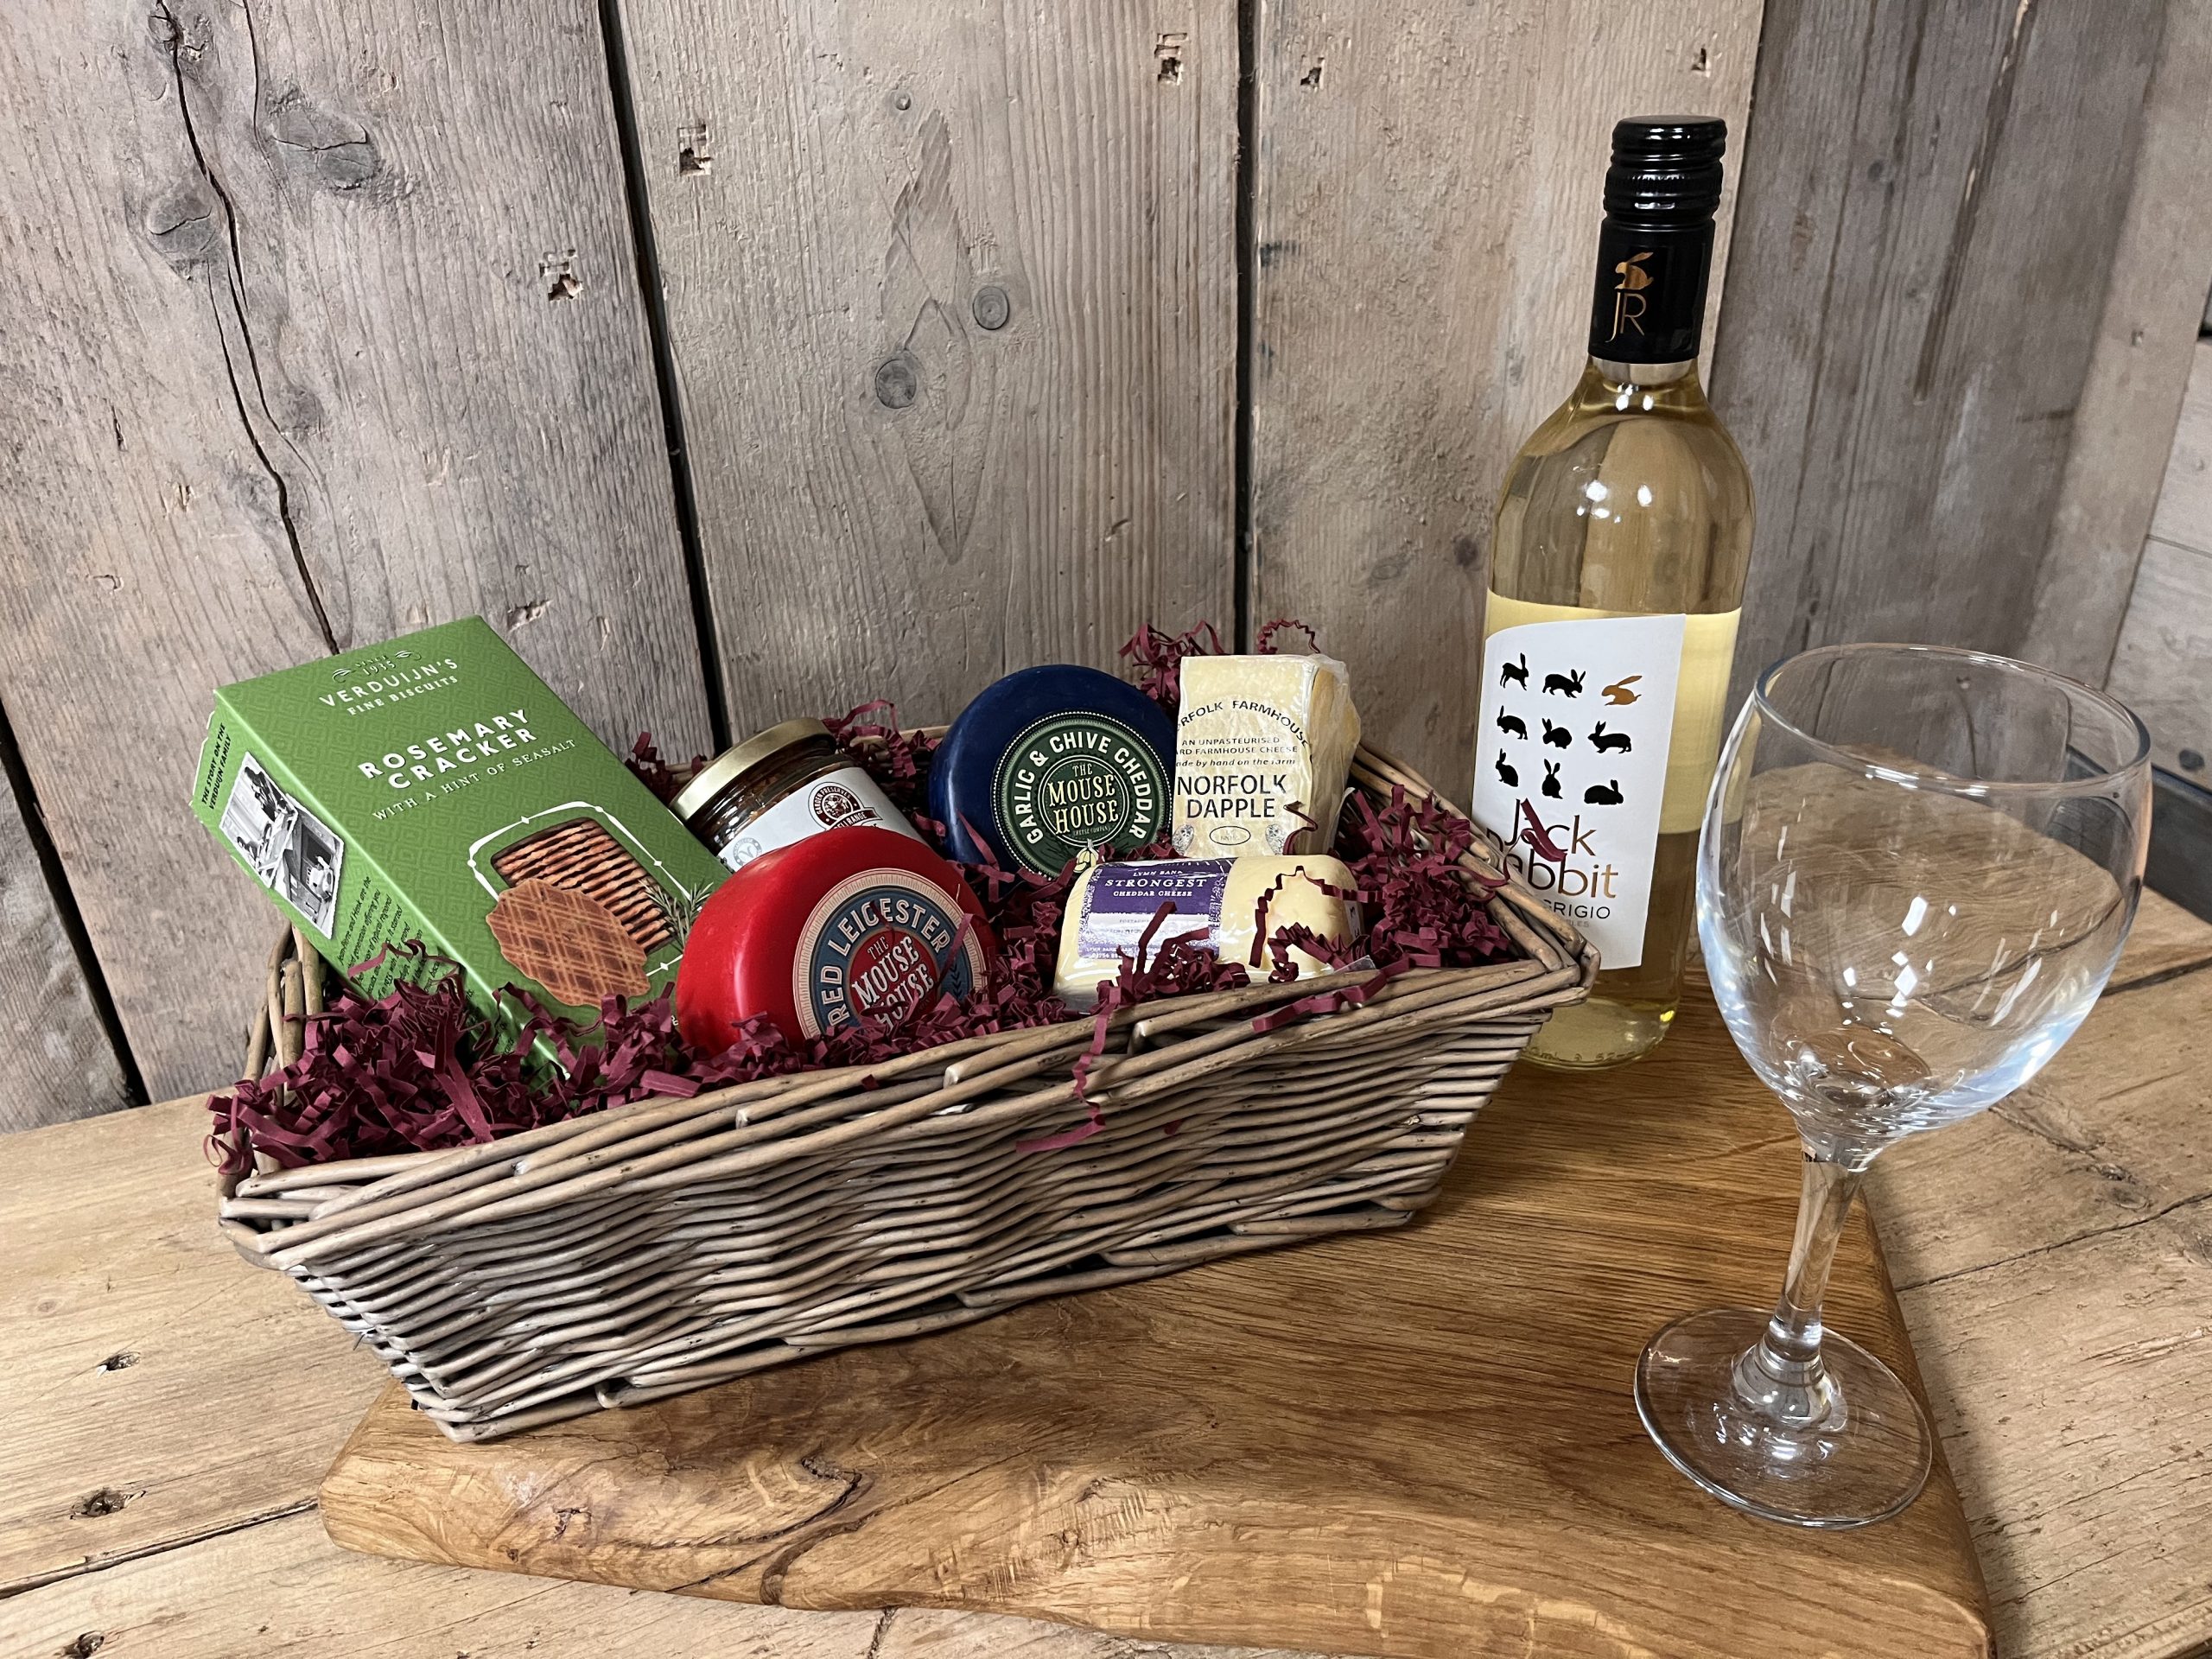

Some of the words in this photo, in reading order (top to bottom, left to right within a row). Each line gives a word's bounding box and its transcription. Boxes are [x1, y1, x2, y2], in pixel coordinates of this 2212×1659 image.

[1605, 292, 1646, 342] JR
[319, 658, 458, 707] VERDUIJN'S
[363, 660, 396, 676] 1935
[346, 697, 385, 715] FINE
[388, 675, 458, 702] BISCUITS
[1178, 702, 1224, 731] RFOLK
[1232, 700, 1308, 748] FARMHOUSE
[219, 733, 232, 768] FAMILY
[357, 708, 530, 779] ROSEMARY
[388, 727, 537, 789] CRACKER
[1195, 747, 1255, 755] FARMHOUSE
[201, 786, 210, 804] THE
[207, 757, 217, 788] STORY
[213, 741, 221, 758] ON
[217, 721, 226, 741] THE
[372, 797, 418, 820] WITH
[424, 791, 436, 801] A
[440, 772, 480, 794] HINT
[486, 762, 506, 776] OF
[514, 739, 577, 767] SEASALT
[1072, 763, 1092, 777] THE
[1196, 760, 1208, 768] by
[1014, 768, 1044, 844] GARLIC
[1029, 750, 1049, 767] &
[1049, 731, 1112, 753] CHIVE
[1114, 747, 1153, 841] CHEDDAR
[1047, 773, 1116, 807] MOUSE
[1177, 774, 1287, 796] NORFOLK
[1053, 799, 1119, 835] HOUSE
[1186, 798, 1275, 819] DAPPLE
[1104, 878, 1207, 887] STRONGEST
[352, 899, 363, 918] Henk
[391, 904, 403, 929] started
[827, 898, 950, 957] LEICESTER
[867, 936, 889, 960] THE
[852, 936, 919, 1010] MOUSE
[821, 964, 850, 1027] RED
